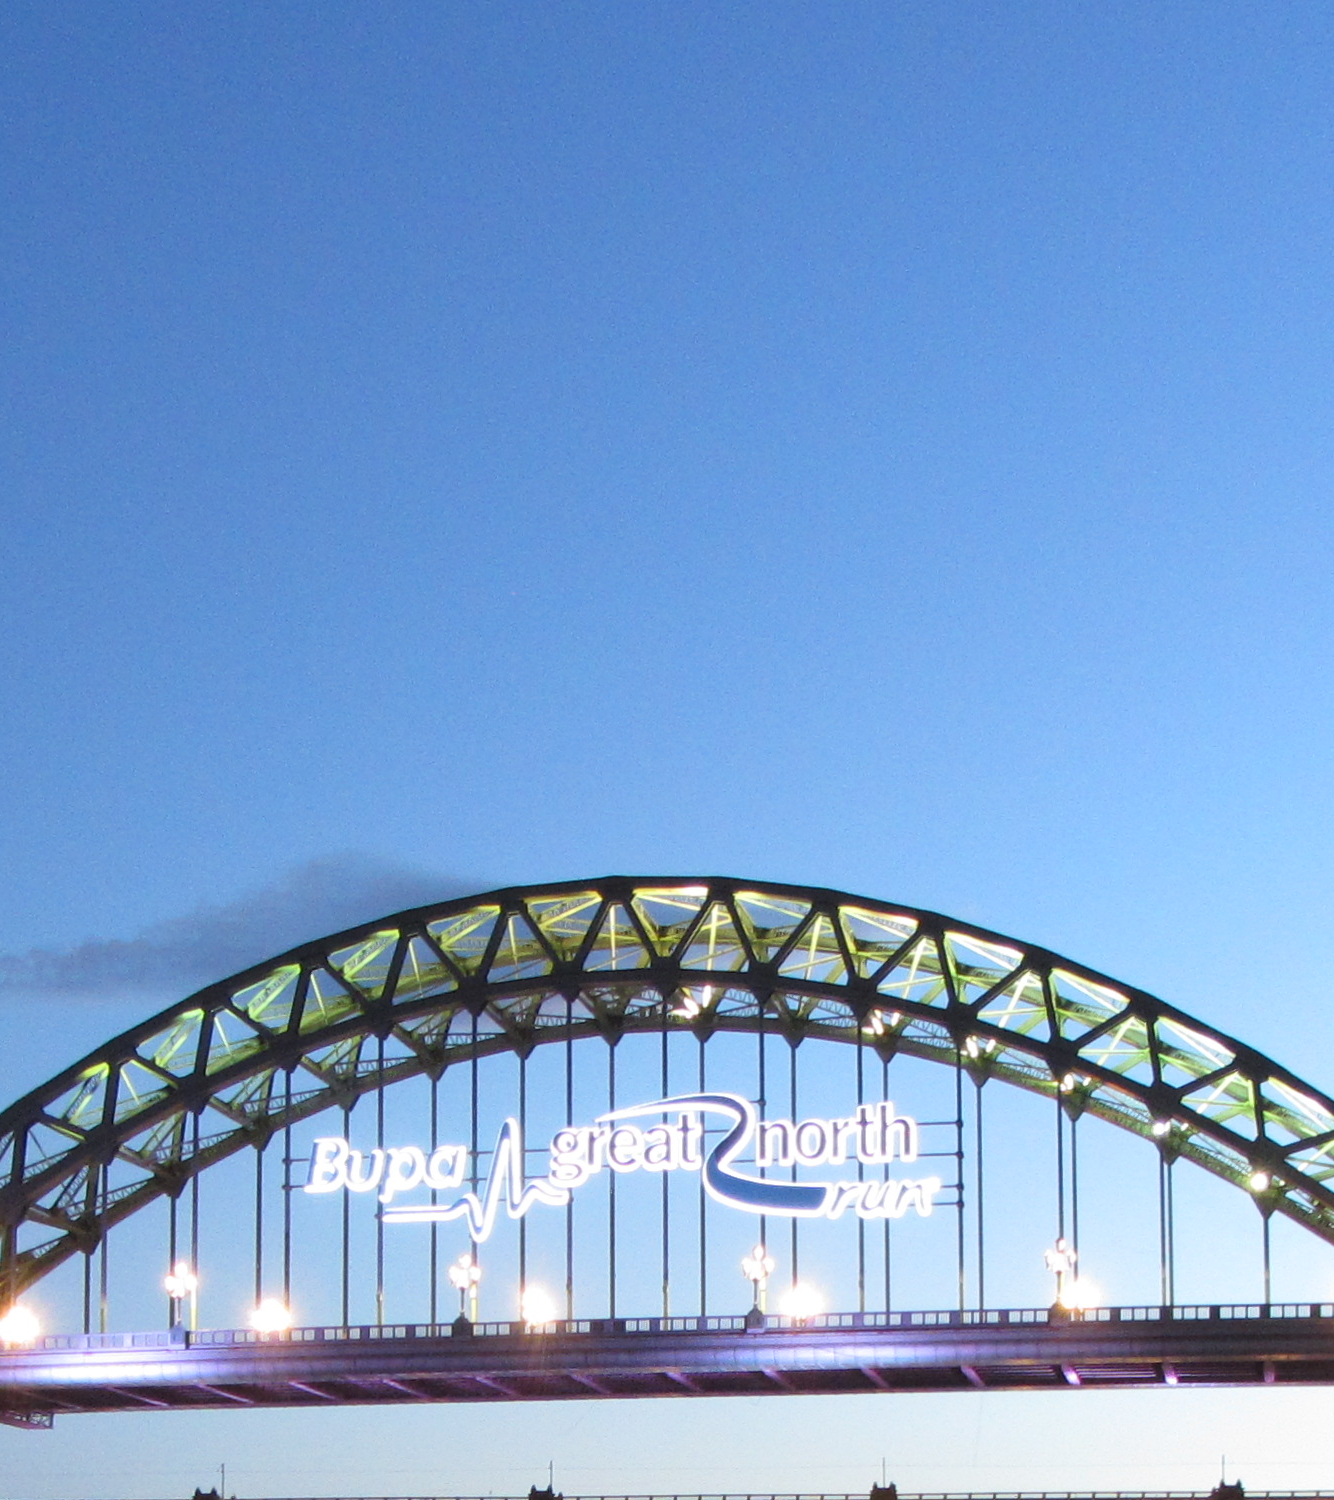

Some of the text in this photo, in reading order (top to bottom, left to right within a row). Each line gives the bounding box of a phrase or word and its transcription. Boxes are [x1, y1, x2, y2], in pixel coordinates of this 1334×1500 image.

[304, 1137, 468, 1204] Bupa
[549, 1102, 918, 1188] great north
[825, 1176, 942, 1220] run
